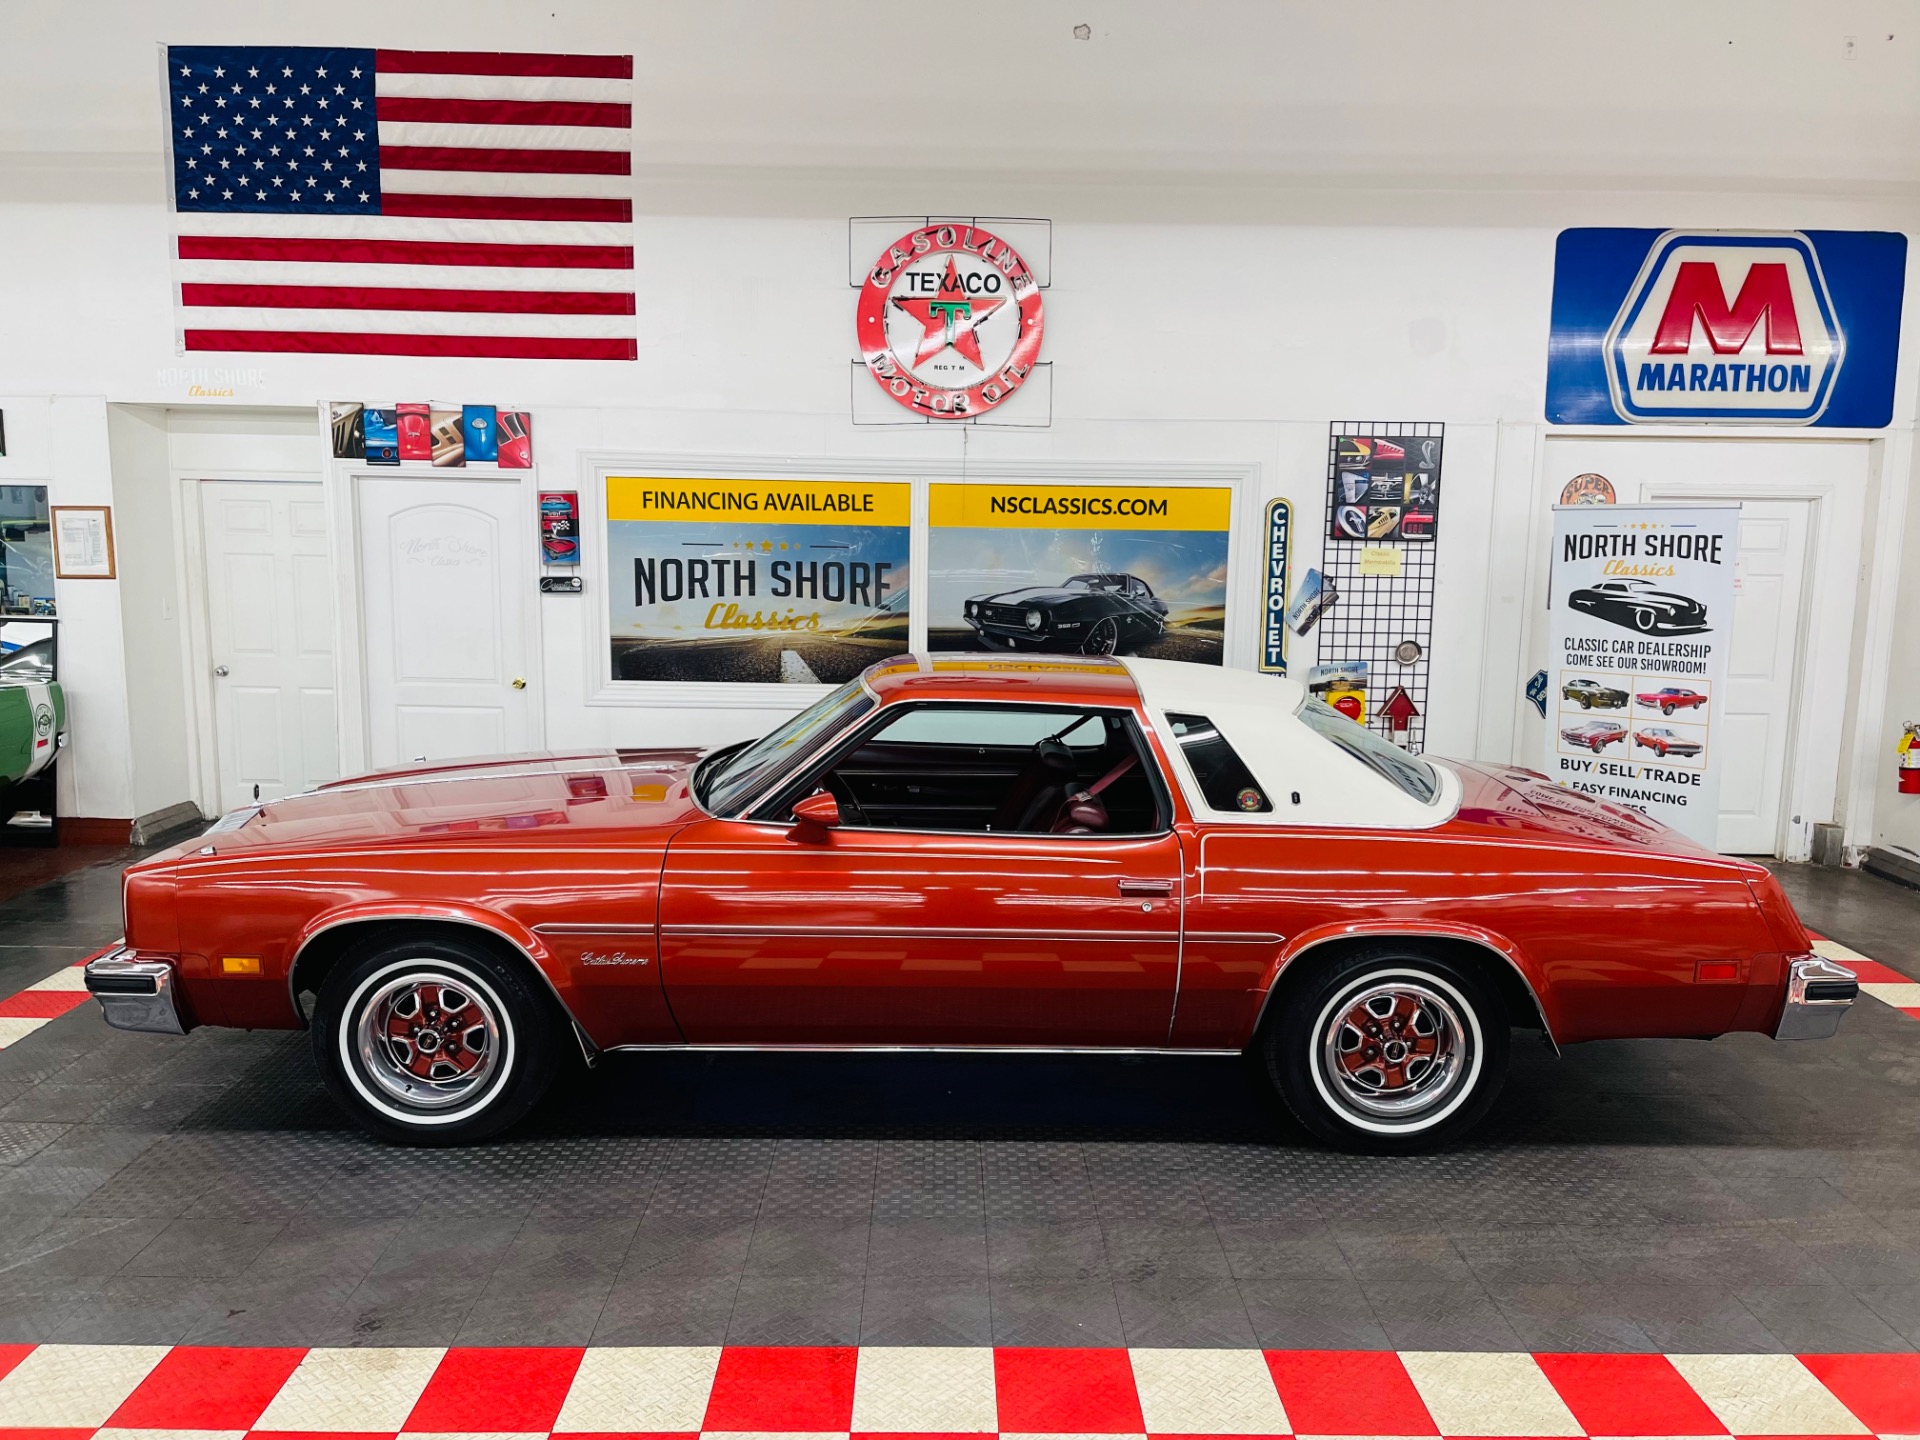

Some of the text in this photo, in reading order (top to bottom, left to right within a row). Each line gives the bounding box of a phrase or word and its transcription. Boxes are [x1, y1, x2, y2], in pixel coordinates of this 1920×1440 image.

[871, 226, 1033, 290] GASOLINE
[905, 272, 1001, 293] TEXACO
[1648, 261, 1805, 356] M
[157, 367, 266, 390] NORTH SHORE
[188, 384, 234, 397] Classics
[871, 353, 1029, 415] MOTOR OIL
[1636, 363, 1811, 393] MARATHON
[1566, 475, 1610, 501] SUPER
[642, 491, 874, 512] FINANCING AVAILABLE
[990, 496, 1168, 516] NSCLASSICS.COM
[1564, 534, 1723, 565] NORTH SHORE
[1603, 559, 1676, 576] Classics
[634, 557, 892, 611] NORTH SHORE
[1268, 508, 1286, 663] CHEVROLET
[704, 602, 821, 631] Classics
[1292, 603, 1308, 621] NORTH
[1564, 637, 1711, 658] CLASSIC CAR DEALERSHIP
[1320, 667, 1339, 677] NORTH
[1340, 665, 1358, 674] SHORE
[1566, 653, 1706, 674] COME SEE OUR SHOWROOM!
[1560, 758, 1701, 786] BUY/SELL/TRADE
[1573, 781, 1687, 806] EASY FINANCING
